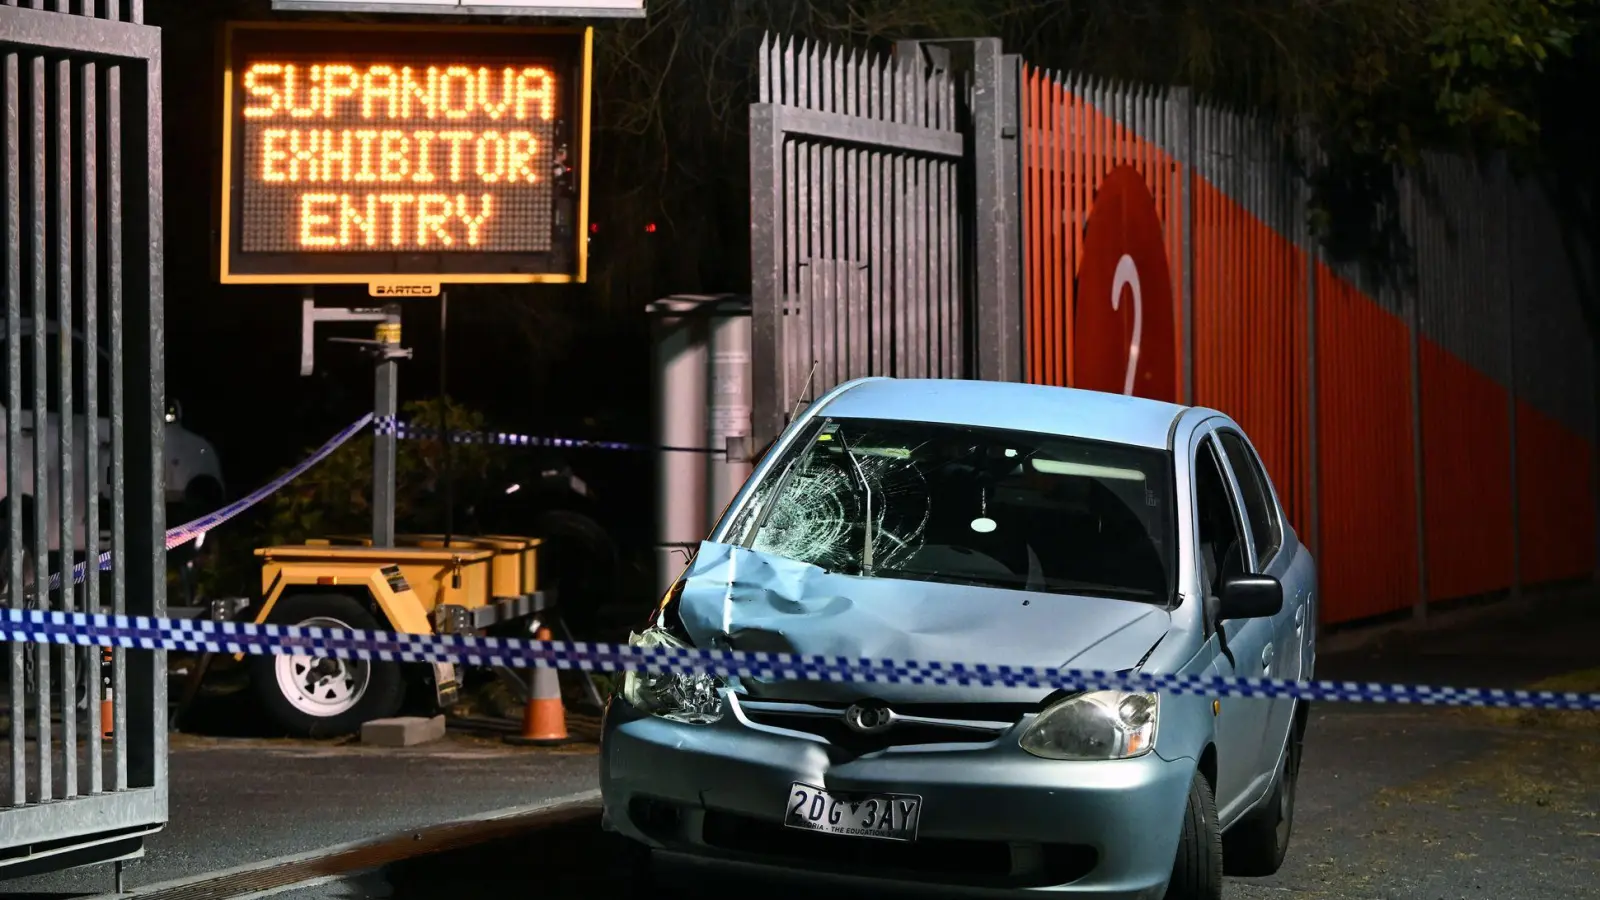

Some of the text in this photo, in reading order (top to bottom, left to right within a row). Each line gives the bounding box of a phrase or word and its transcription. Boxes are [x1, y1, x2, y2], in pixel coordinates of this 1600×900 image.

[243, 63, 555, 120] SUPANOVA
[262, 128, 538, 183] EXHIBITOR
[301, 193, 492, 247] ENTRY
[376, 285, 433, 295] BARTCO
[789, 790, 917, 831] 2DG 3AY
[831, 826, 845, 834] THE
